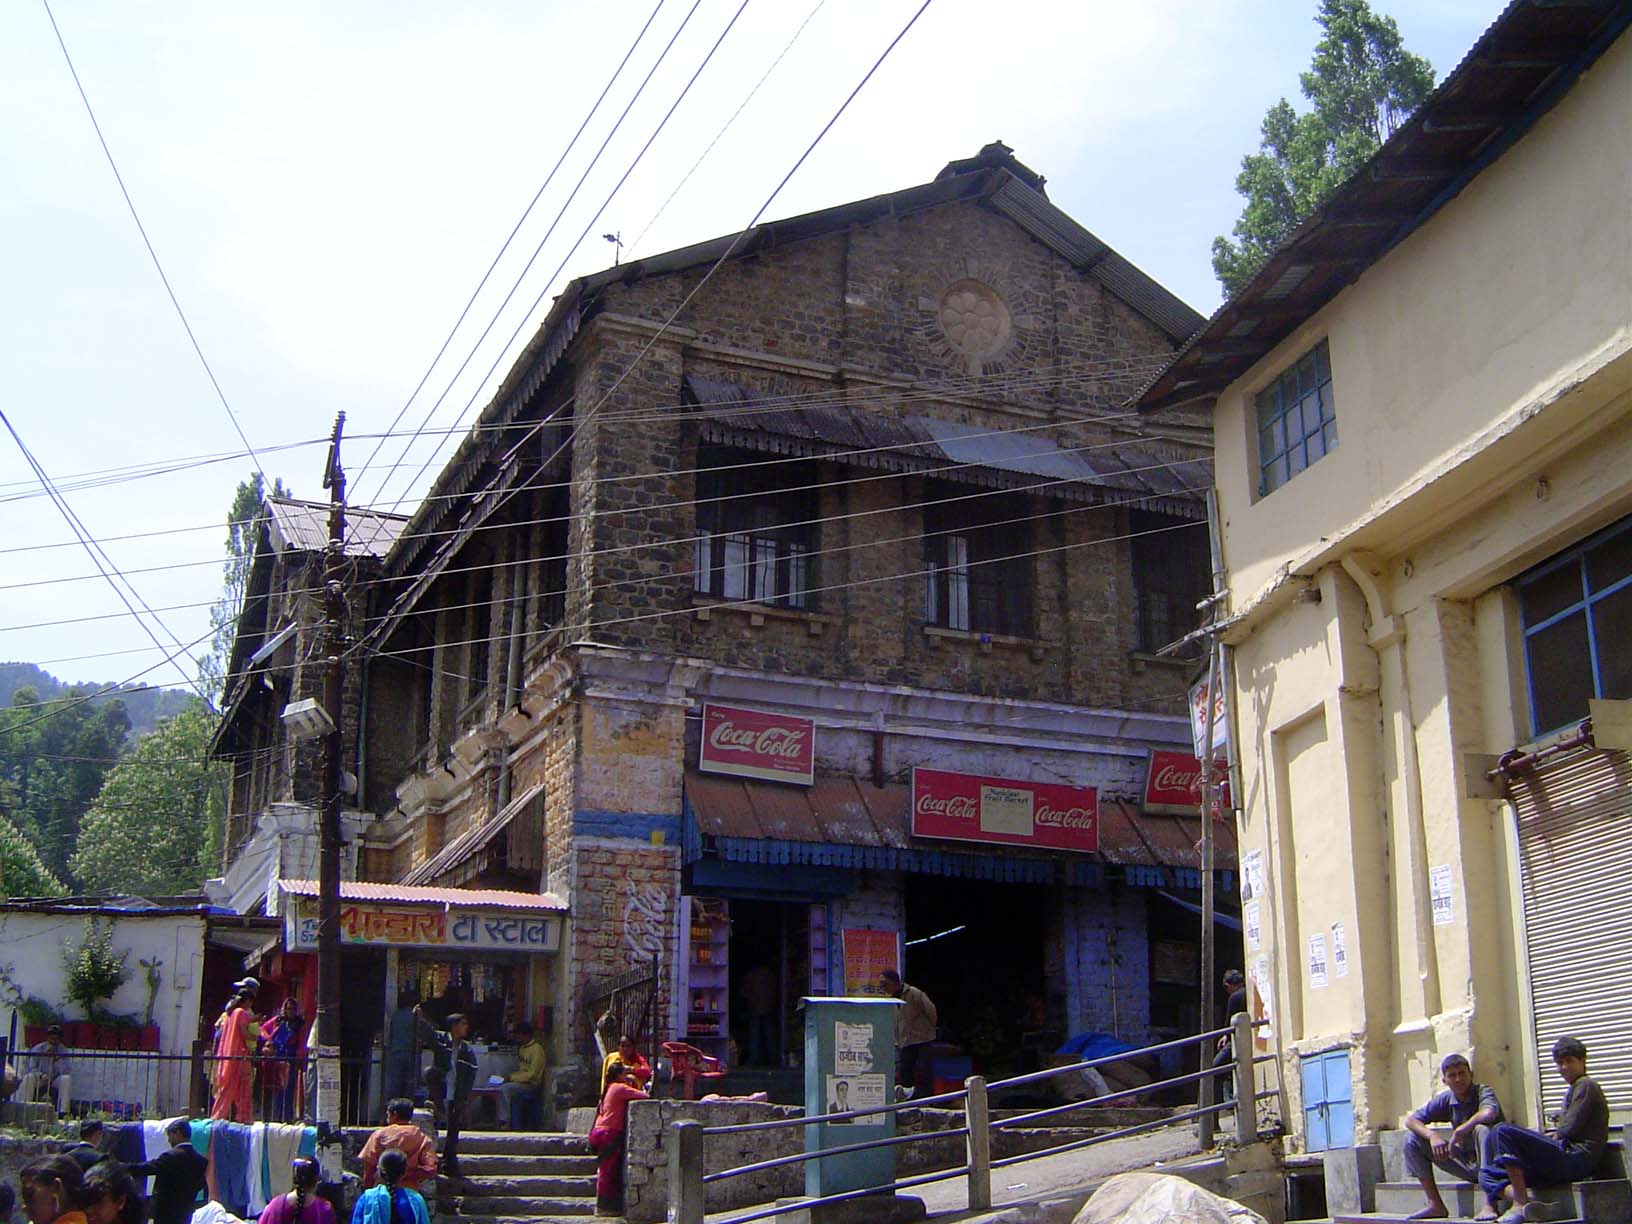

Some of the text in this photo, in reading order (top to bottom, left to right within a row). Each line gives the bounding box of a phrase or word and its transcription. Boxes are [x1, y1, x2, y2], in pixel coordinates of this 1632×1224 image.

[710, 721, 806, 758] Coca-Cola
[917, 794, 977, 818] Coca-Cola
[1035, 805, 1095, 829] Coca-Cola
